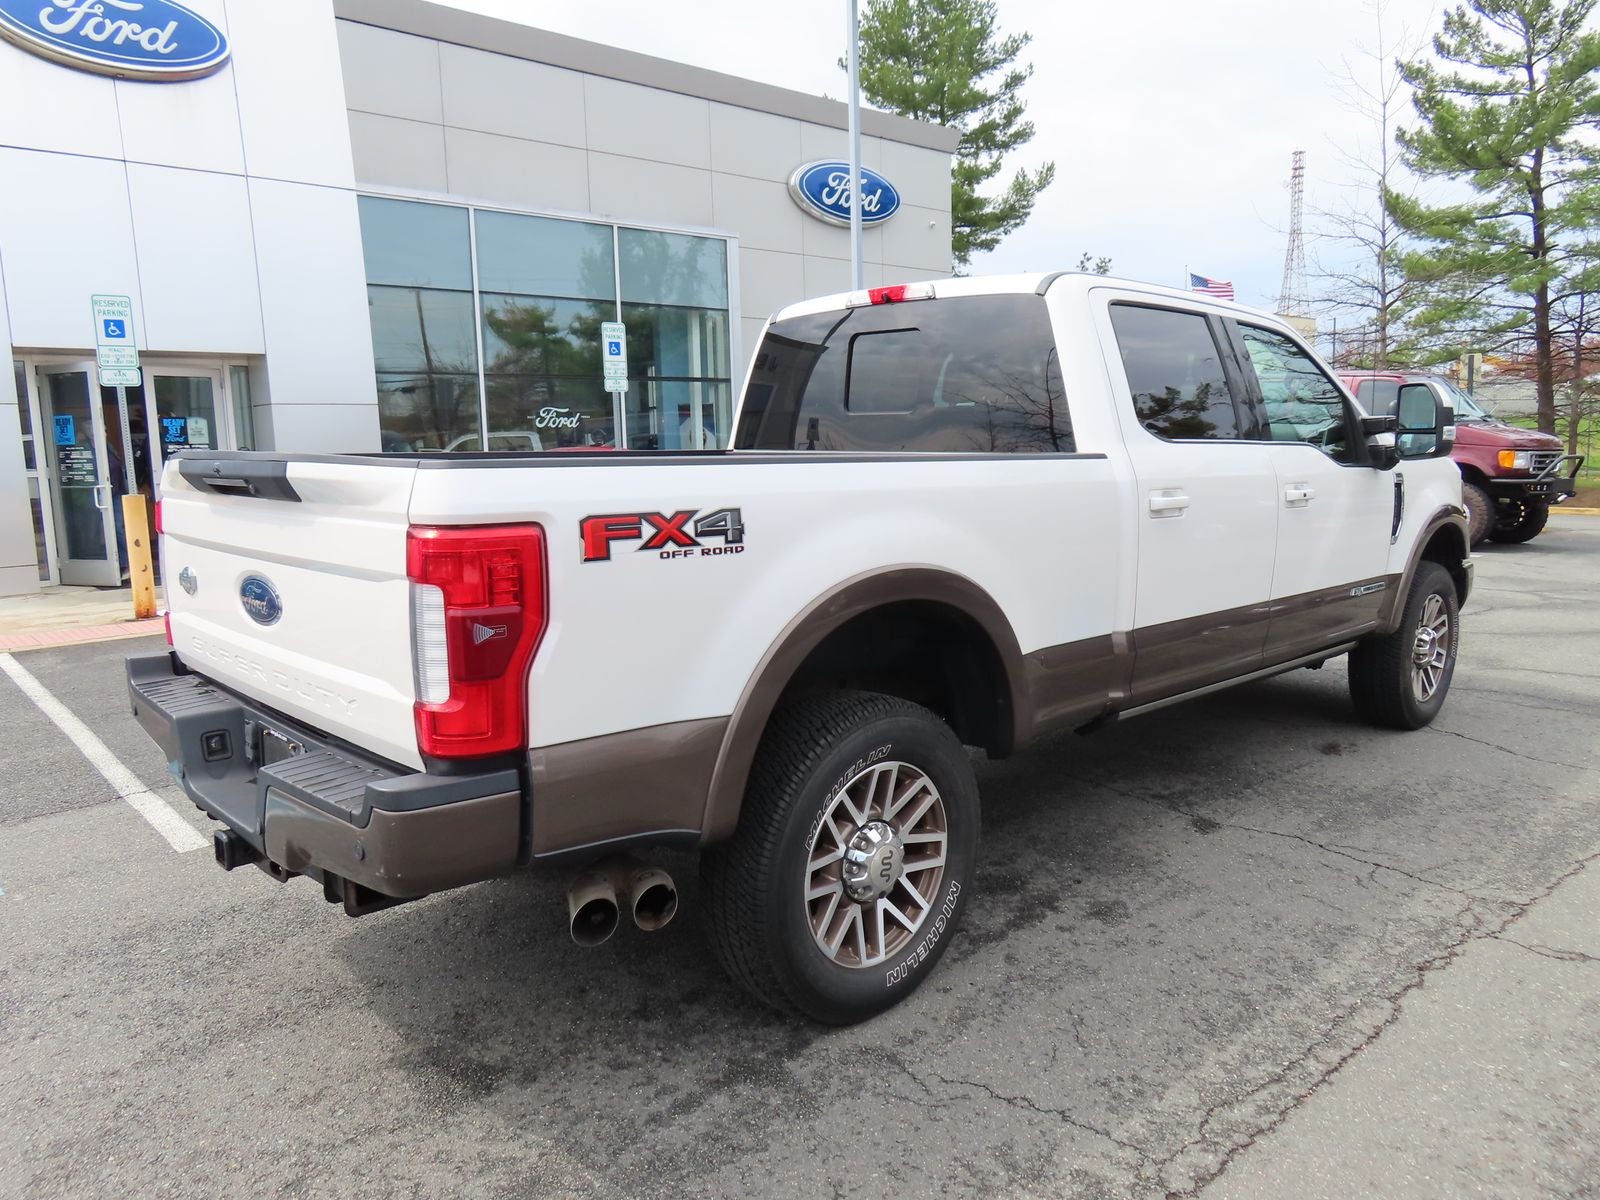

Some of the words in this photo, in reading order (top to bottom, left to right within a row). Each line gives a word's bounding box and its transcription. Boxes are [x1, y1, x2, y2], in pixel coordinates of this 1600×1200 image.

[39, 0, 178, 54] Ford
[94, 300, 129, 308] RESERVED
[97, 309, 128, 317] PARKING
[163, 419, 185, 427] READY
[535, 407, 580, 428] Ford
[168, 426, 180, 434] SET
[579, 507, 746, 563] FX4
[659, 549, 695, 560] OFF
[701, 545, 745, 557] ROAD
[192, 636, 268, 682] SUPER
[272, 670, 359, 716] DUTY
[805, 744, 892, 851] MICHELIN
[886, 880, 961, 987] MICHELIN
